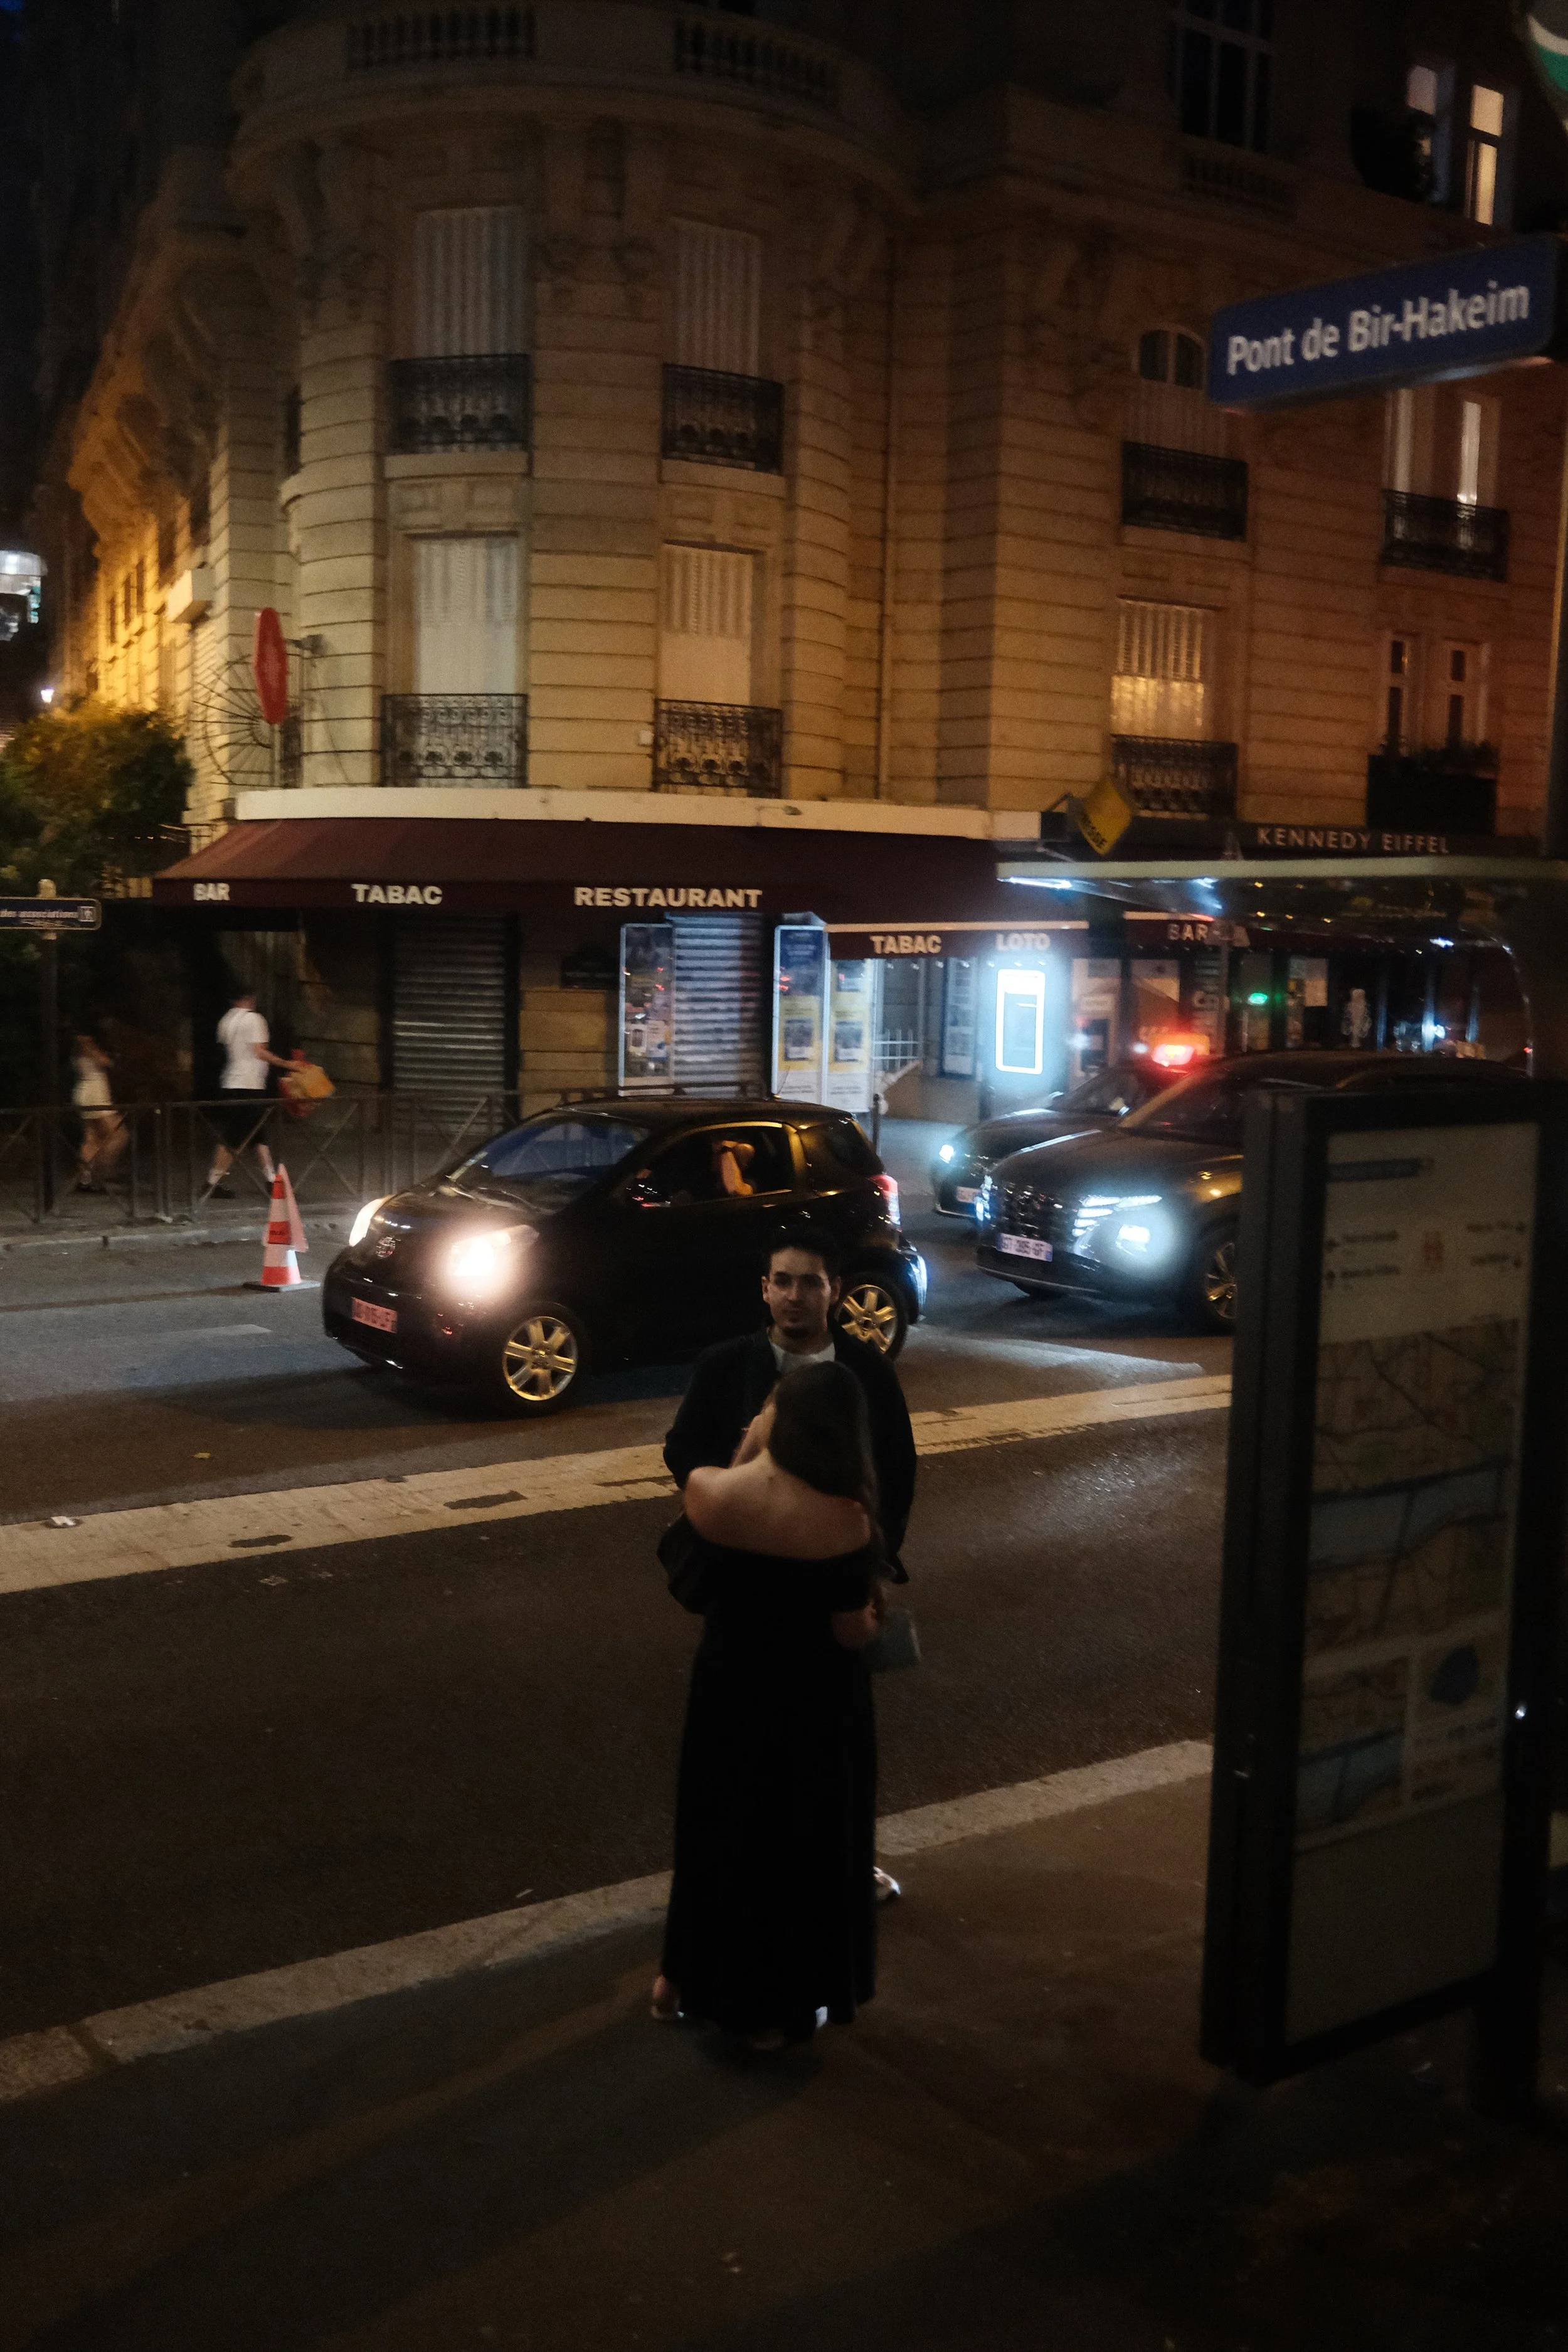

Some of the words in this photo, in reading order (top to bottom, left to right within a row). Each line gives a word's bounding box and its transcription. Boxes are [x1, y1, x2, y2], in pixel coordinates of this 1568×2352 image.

[1226, 328, 1294, 375] Pont
[1301, 317, 1339, 361] de
[1348, 280, 1530, 351] Bir-Hakeim
[1258, 827, 1371, 849] KENNEDY
[1382, 834, 1448, 854] EIFFEL
[193, 882, 230, 901] BAR
[351, 884, 442, 904] TABAC
[574, 887, 763, 908] RESTAURANT
[1167, 923, 1209, 941] BAR
[870, 935, 941, 954] TABAC
[996, 933, 1050, 951] LOTO
